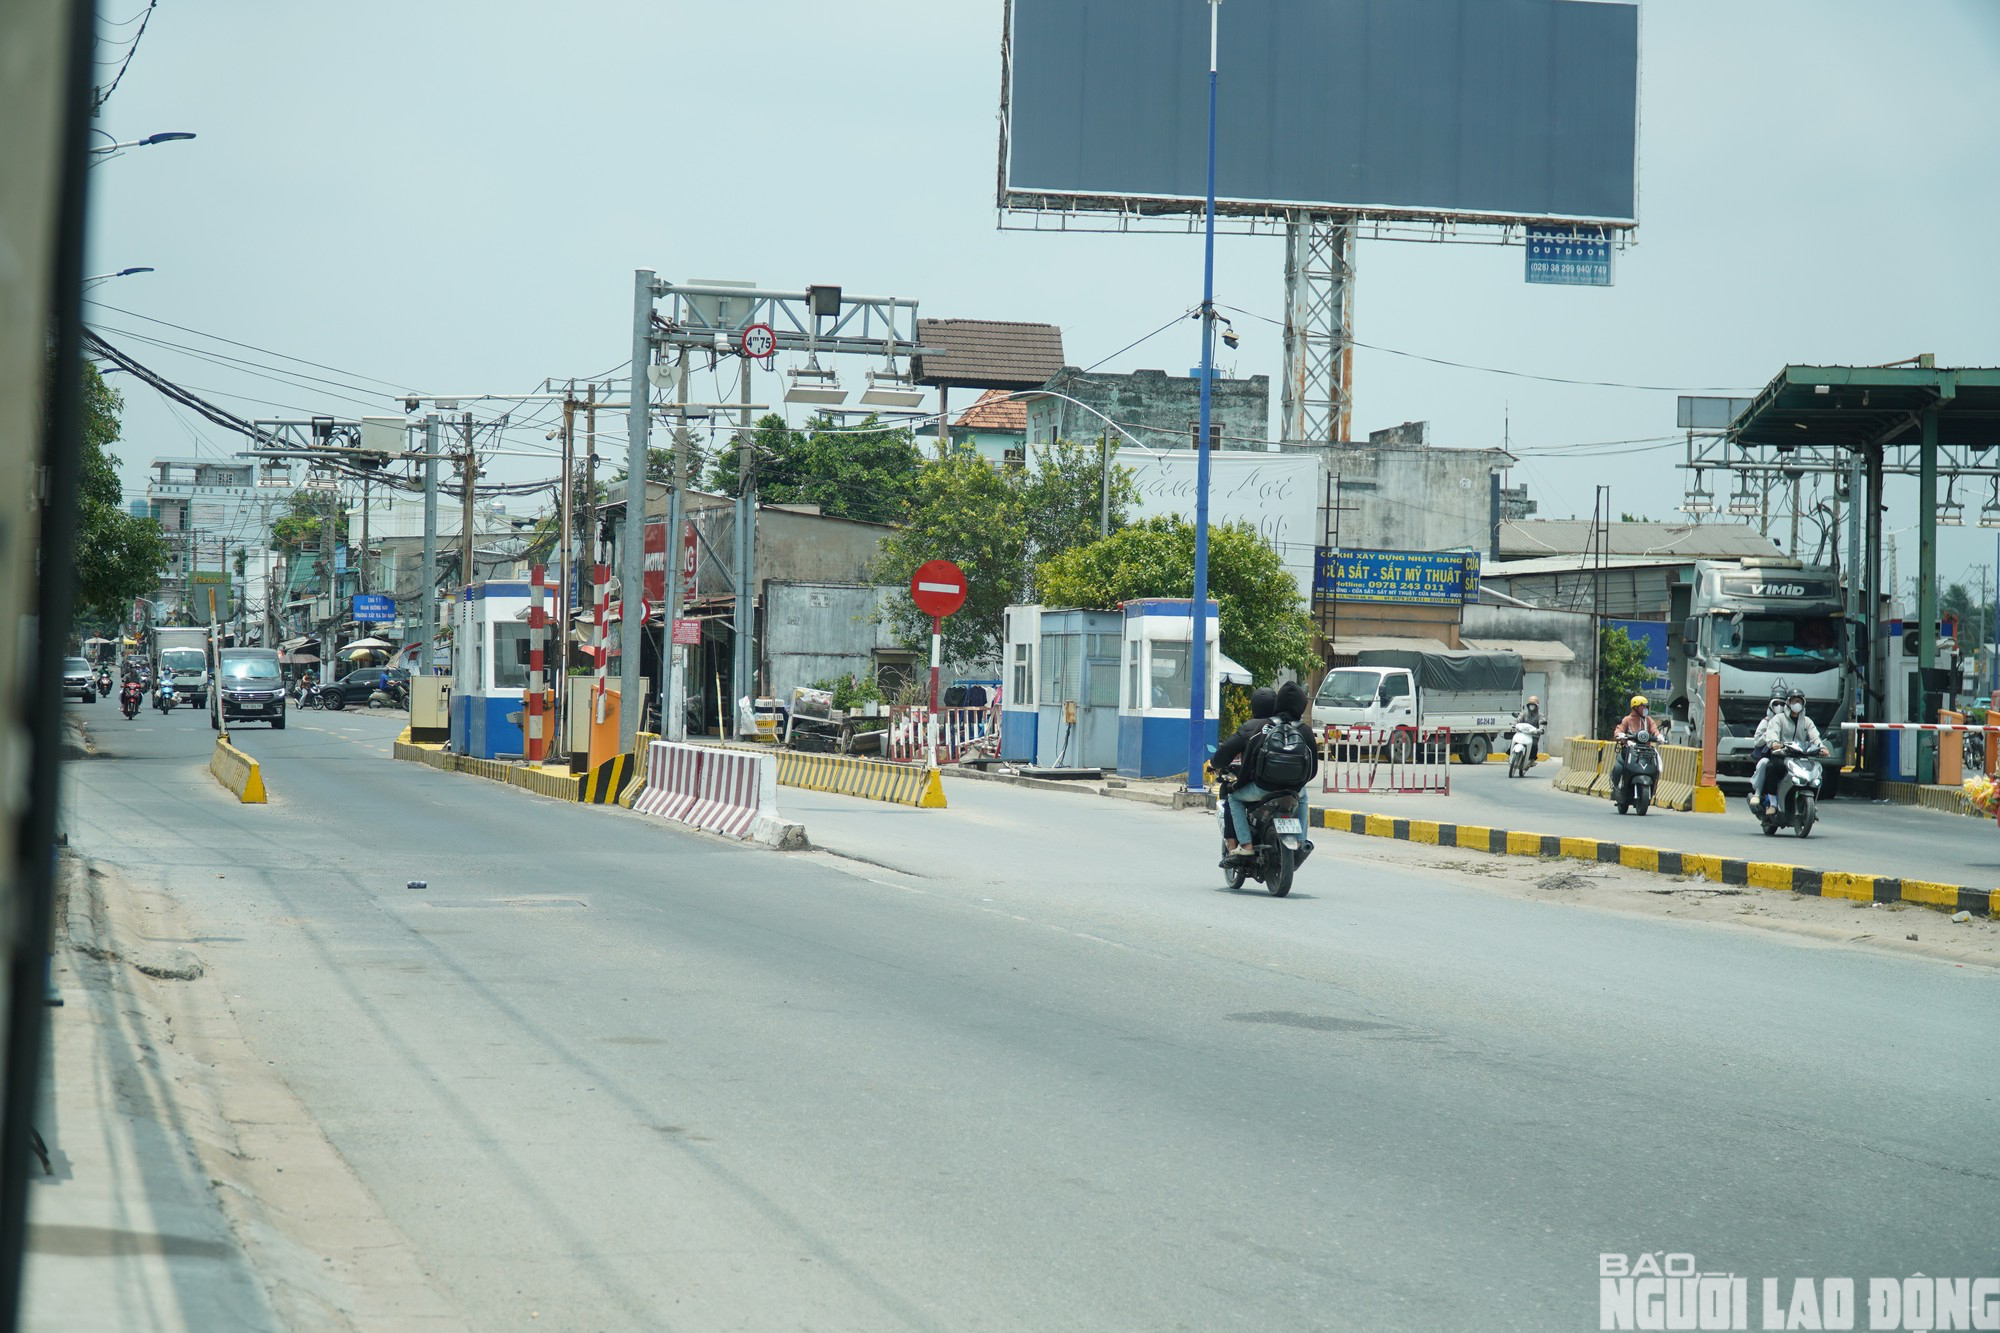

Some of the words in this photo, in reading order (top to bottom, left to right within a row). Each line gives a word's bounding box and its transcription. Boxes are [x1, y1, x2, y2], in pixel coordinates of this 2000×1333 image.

[1532, 231, 1605, 246] PACIFIC
[1533, 246, 1605, 256] OUTDOOR
[1530, 262, 1549, 272] (028)
[1561, 264, 1575, 272] 299
[1593, 265, 1607, 274] 749
[1465, 551, 1479, 571] CỬA
[1322, 559, 1345, 578] CỬA
[1348, 560, 1370, 579] SẮT
[1380, 561, 1402, 581] SẮT
[1405, 565, 1422, 581] MỸ
[1425, 566, 1461, 586] THUẬT
[1368, 581, 1397, 589] 0978
[1400, 582, 1421, 590] 243
[1424, 583, 1444, 591] 011
[1464, 572, 1479, 591] SẮT
